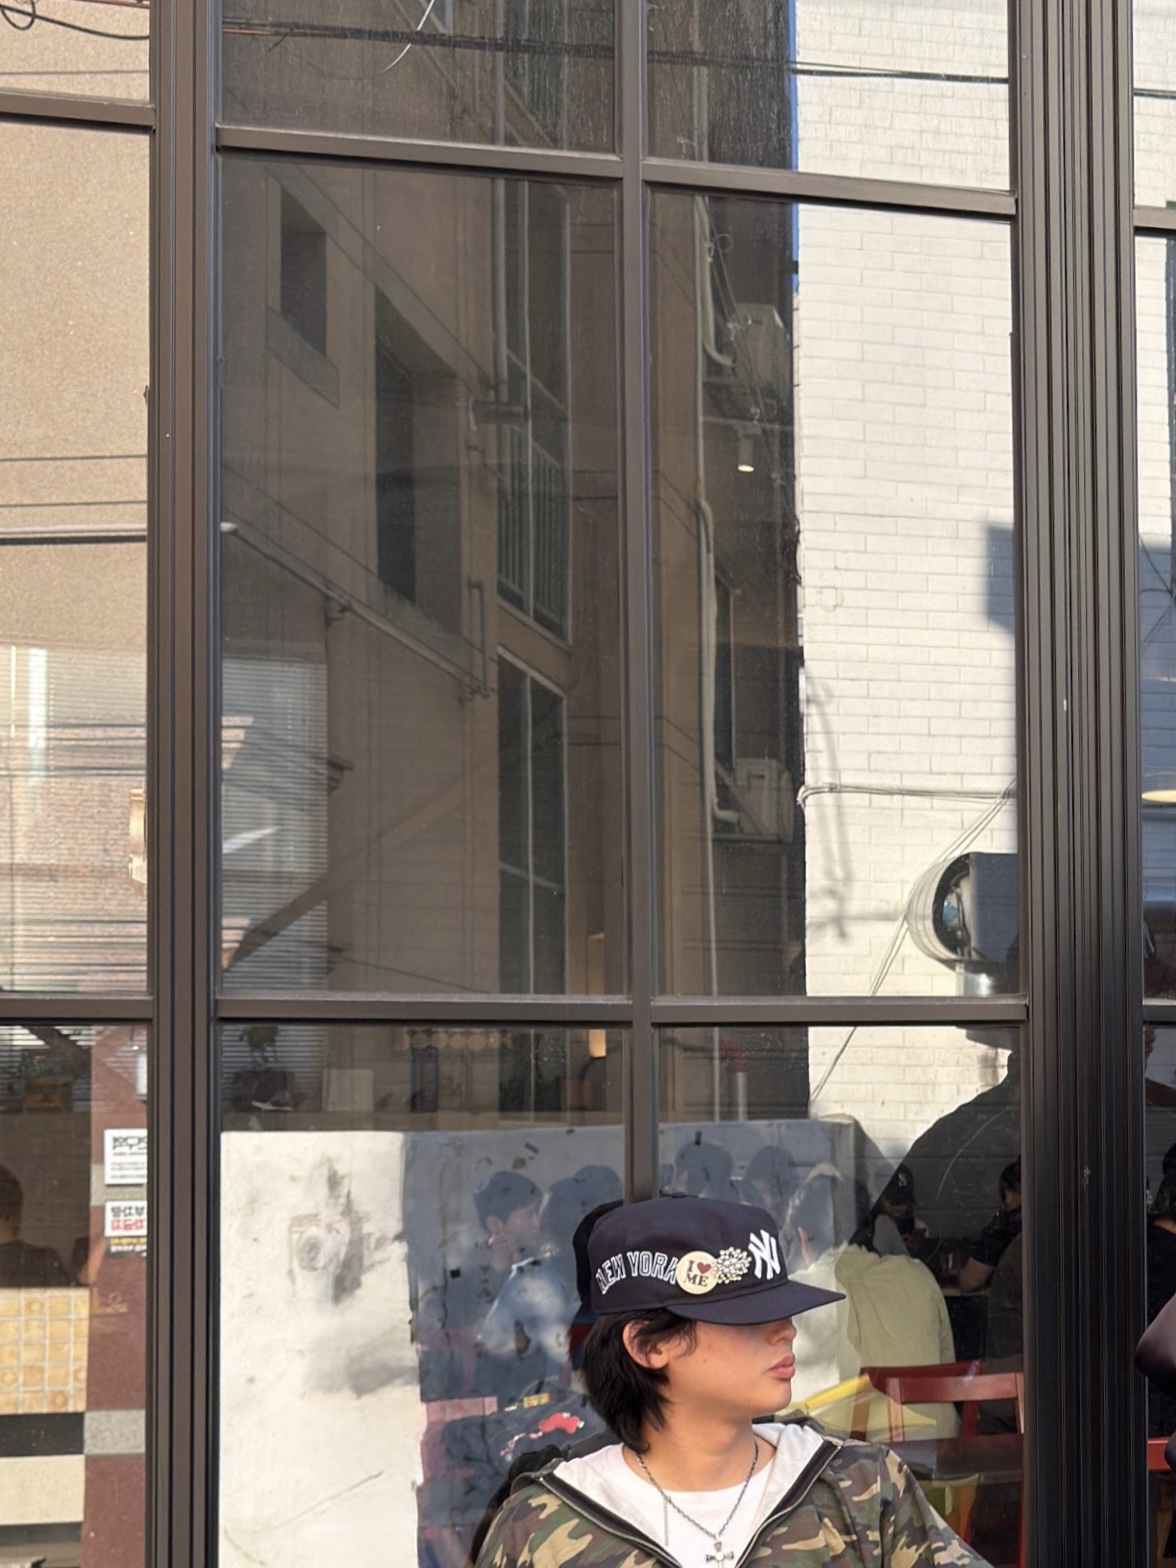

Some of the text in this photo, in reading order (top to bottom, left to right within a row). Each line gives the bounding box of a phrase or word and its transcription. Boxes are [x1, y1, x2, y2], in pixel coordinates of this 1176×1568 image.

[687, 1259, 695, 1272] I
[748, 1229, 781, 1280] NY
[595, 1250, 679, 1295] NEW YORK
[683, 1273, 709, 1287] ME
